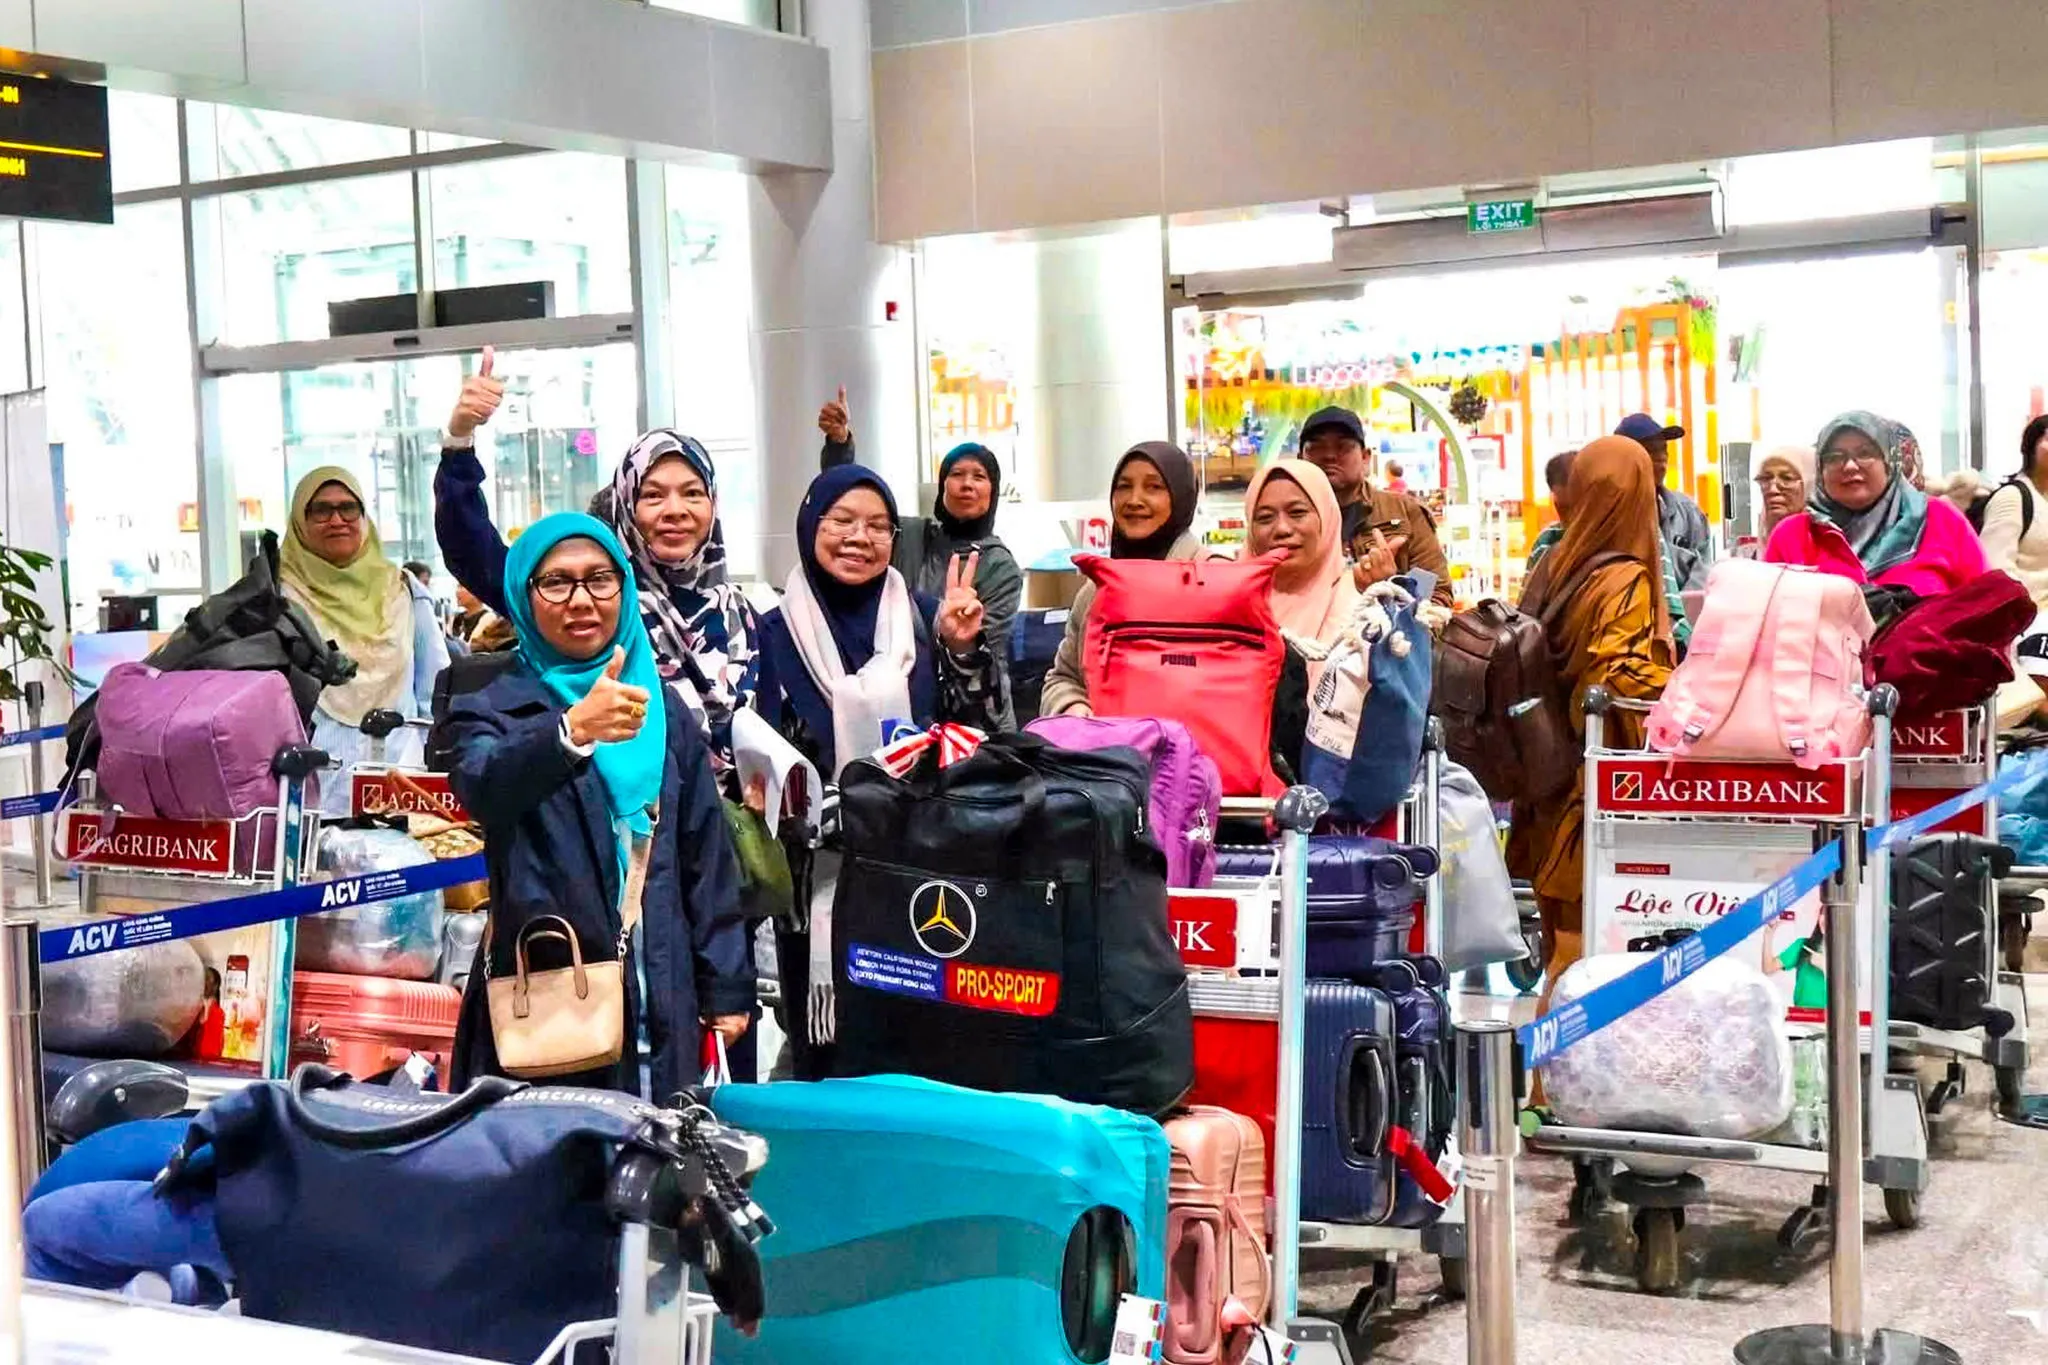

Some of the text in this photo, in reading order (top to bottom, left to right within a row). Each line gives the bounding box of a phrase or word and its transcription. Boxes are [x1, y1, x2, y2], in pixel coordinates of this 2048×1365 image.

[1476, 202, 1525, 221] EXIT
[387, 790, 461, 813] AGRIB
[1648, 779, 1829, 804] AGRIBANK
[101, 833, 219, 862] AGRIBANK
[321, 879, 361, 907] ACV
[67, 923, 118, 955] ACV
[957, 967, 1046, 1005] PRO-SPORT
